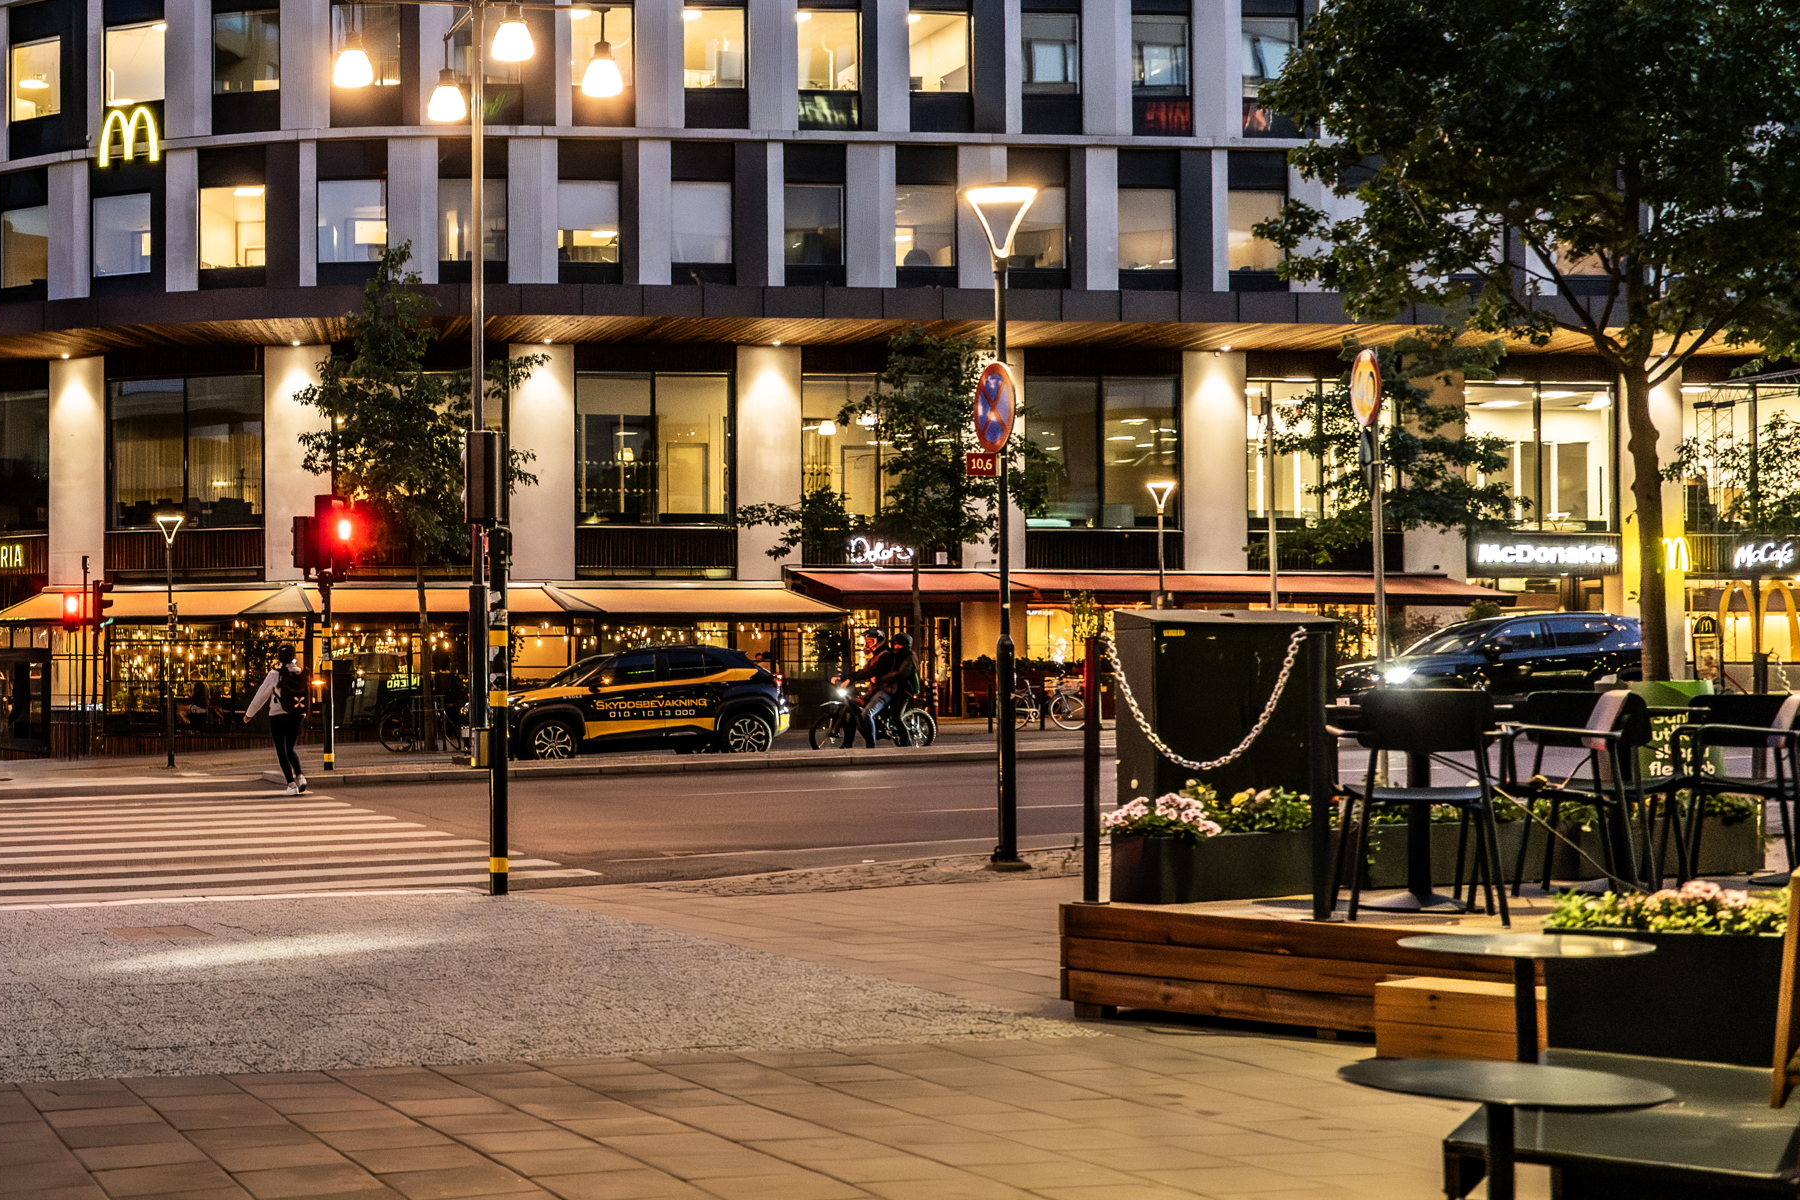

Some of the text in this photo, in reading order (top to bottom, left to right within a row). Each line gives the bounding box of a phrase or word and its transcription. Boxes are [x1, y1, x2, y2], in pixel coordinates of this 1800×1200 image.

[1356, 371, 1376, 406] 40
[1477, 544, 1618, 564] McDonald's
[596, 698, 707, 709] SKYDDSBEVAKNING
[660, 709, 671, 717] 13
[675, 708, 696, 716] 000
